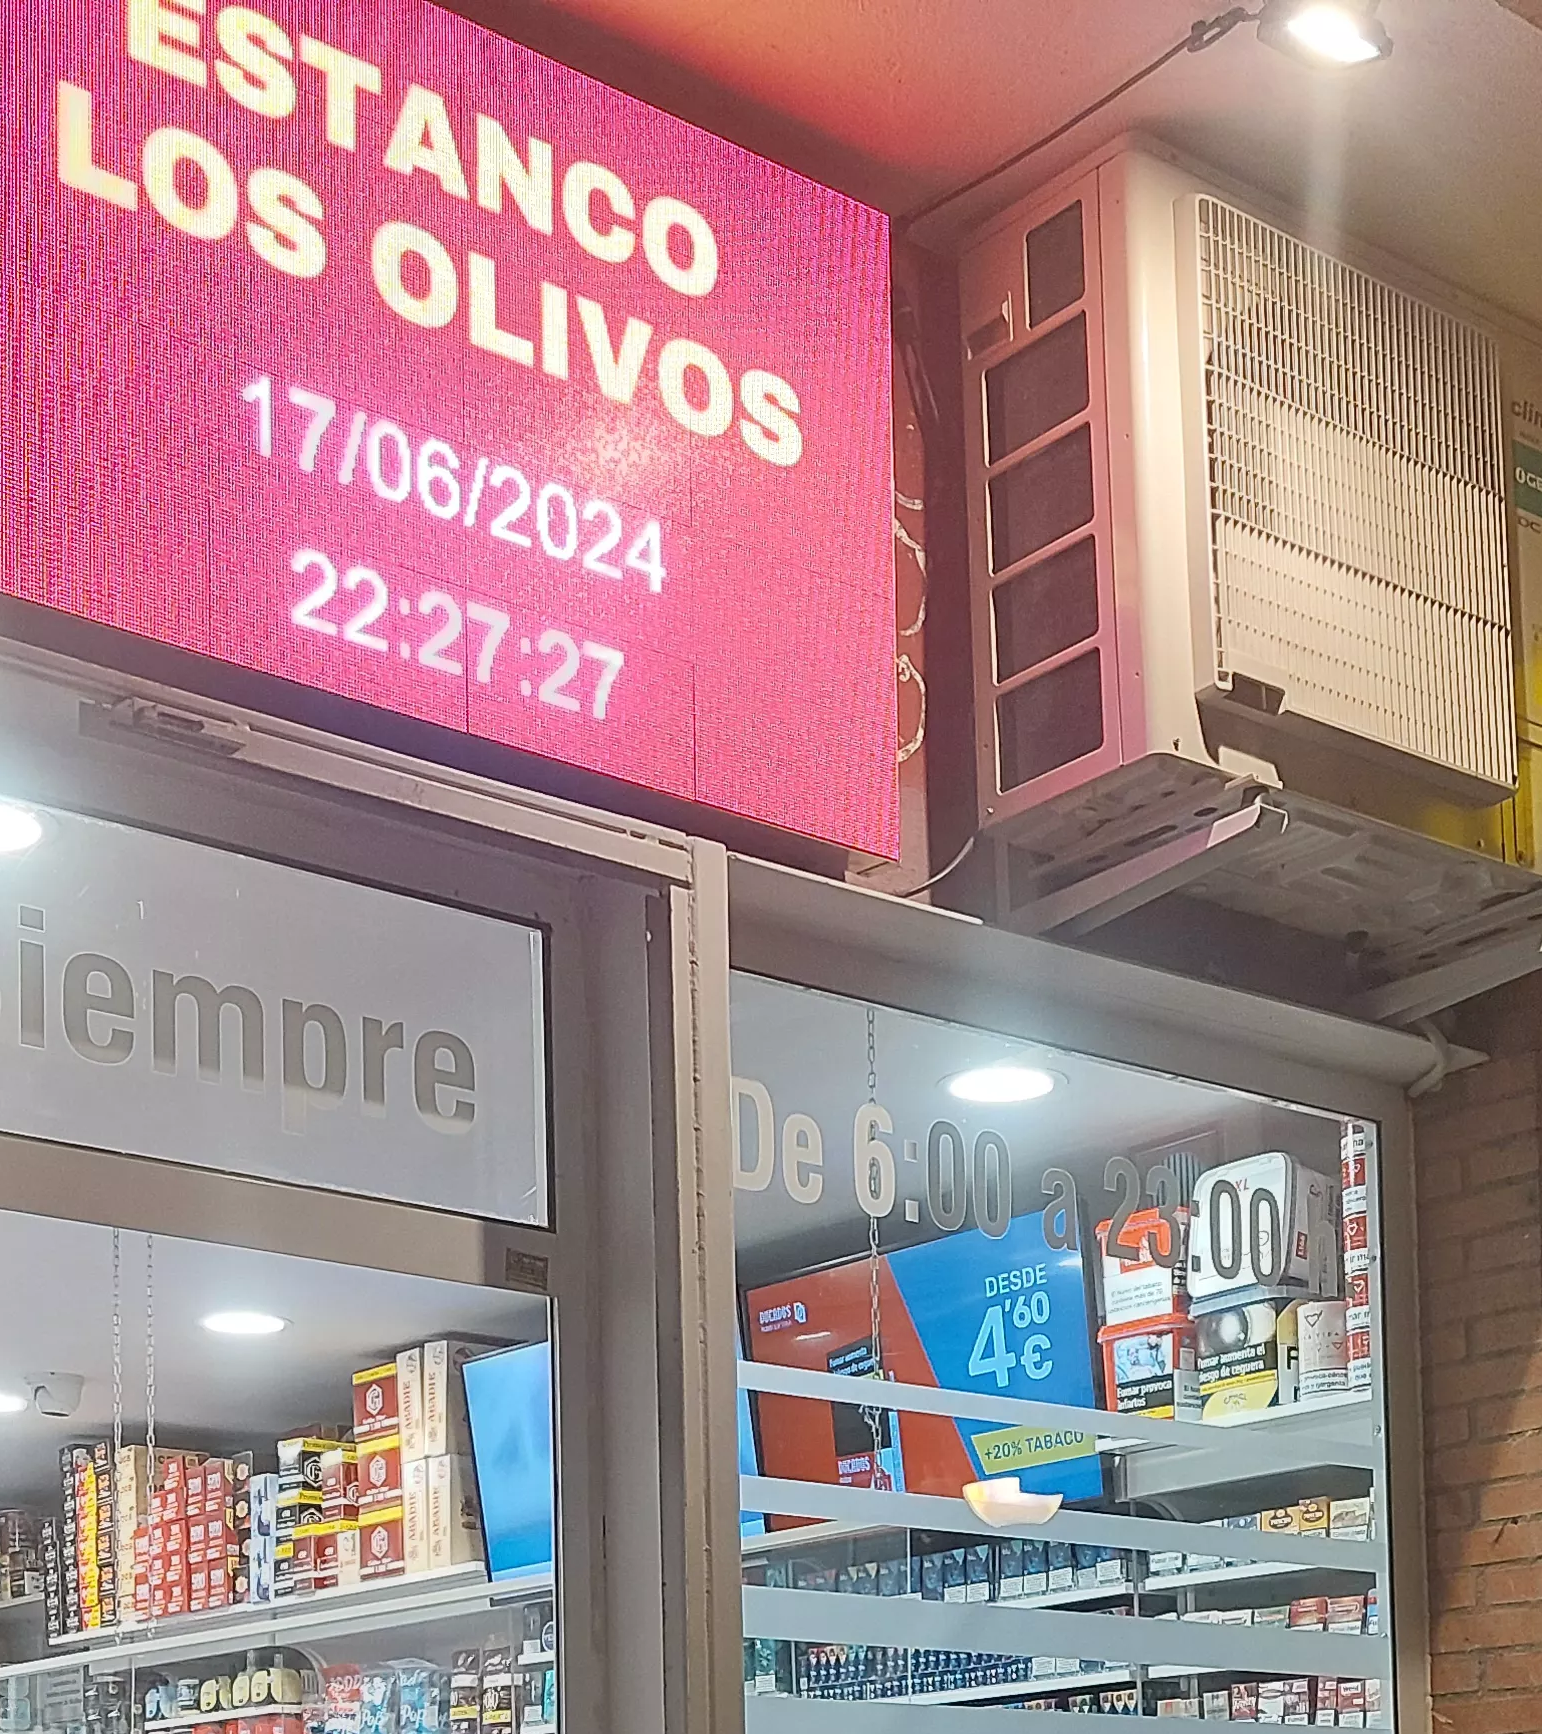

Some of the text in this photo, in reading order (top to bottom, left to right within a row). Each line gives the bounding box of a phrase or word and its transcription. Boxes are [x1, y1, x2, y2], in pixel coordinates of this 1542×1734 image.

[125, 0, 720, 298] ESTANCO
[56, 80, 804, 469] LOS OLIVOS
[241, 375, 668, 594] 17/06/2024
[289, 547, 625, 721] 22:27:27
[732, 1076, 825, 1204] De
[854, 1102, 1013, 1240] 6:00
[1042, 1165, 1077, 1252] a
[1102, 1156, 1282, 1289] 23:00
[984, 1262, 1048, 1299] DESDE
[984, 1430, 1084, 1461] +20% TABACO
[1143, 1379, 1173, 1396] provoca
[1231, 1359, 1265, 1377] ceguera
